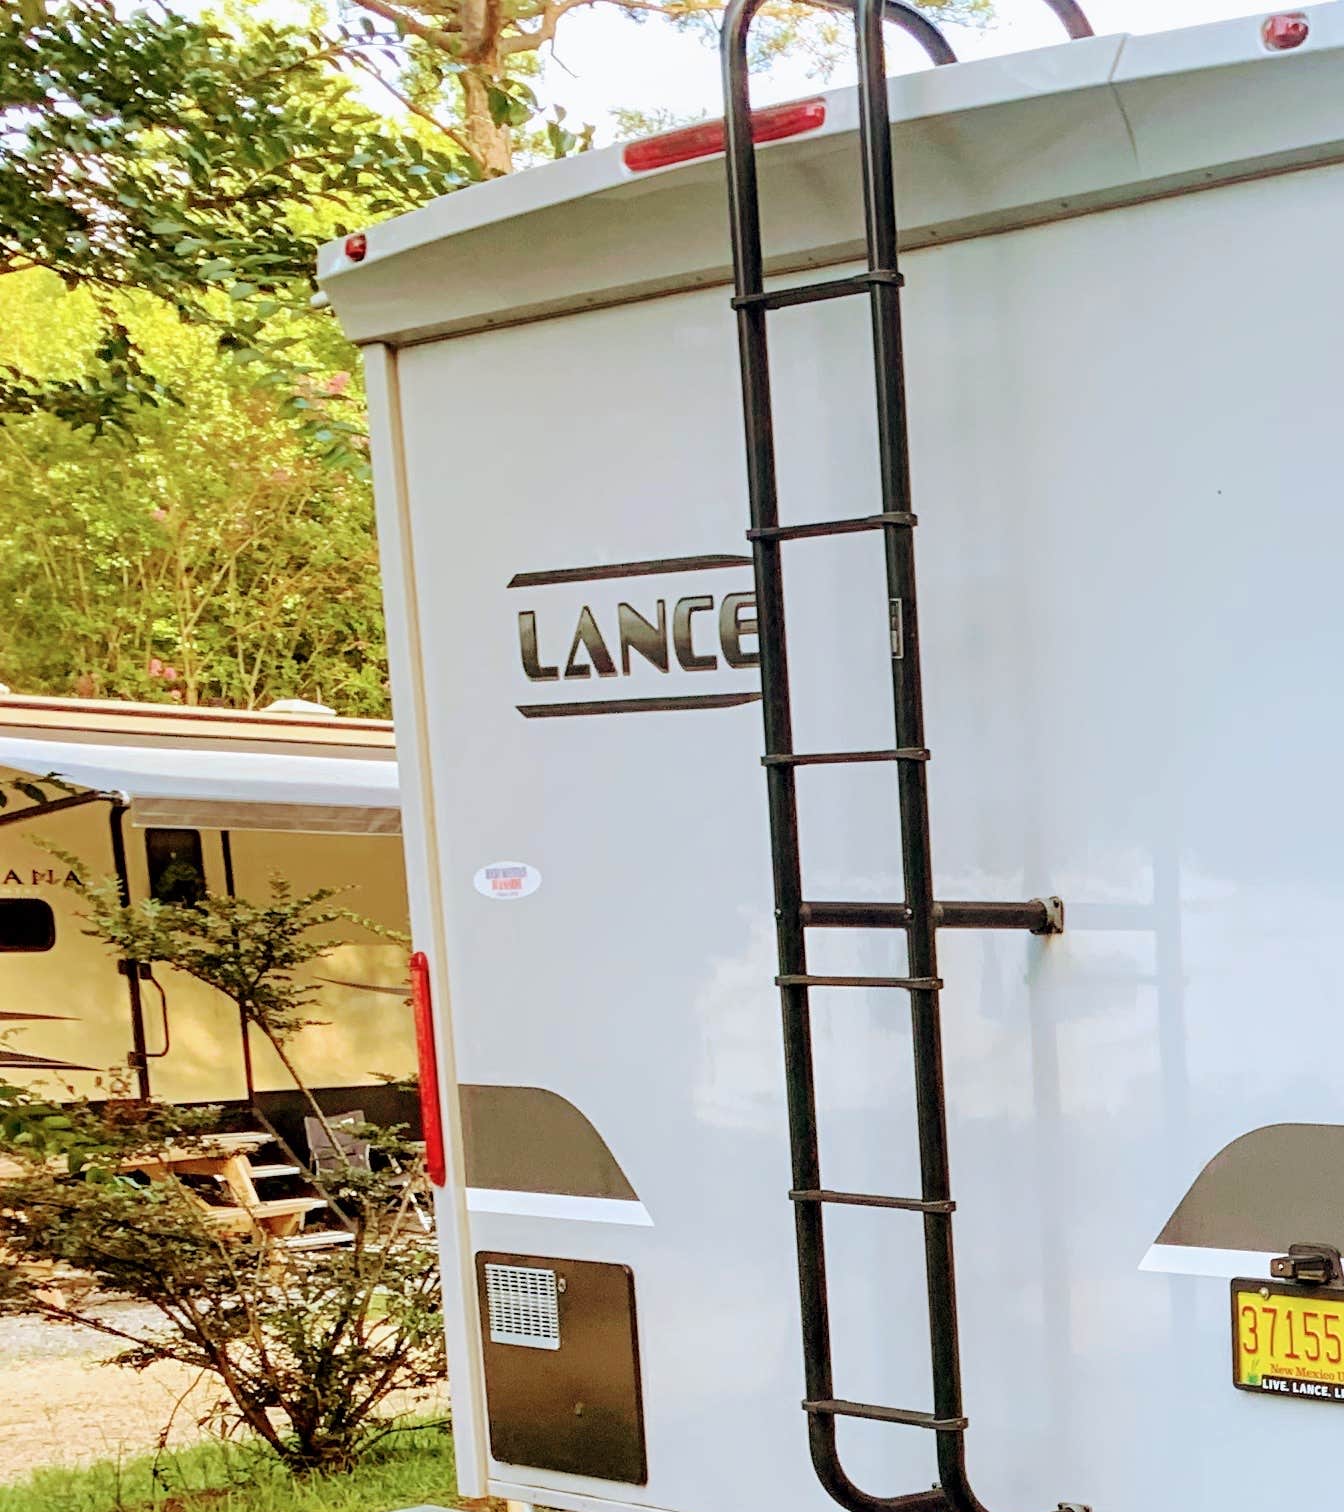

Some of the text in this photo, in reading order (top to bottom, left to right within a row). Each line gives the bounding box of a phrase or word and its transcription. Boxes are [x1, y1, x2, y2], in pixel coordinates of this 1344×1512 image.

[517, 590, 761, 681] LANCE
[1269, 1363, 1294, 1376] New
[1295, 1366, 1335, 1381] Mexico
[1262, 1378, 1290, 1392] LIVE.
[1292, 1382, 1332, 1398] LANCE.
